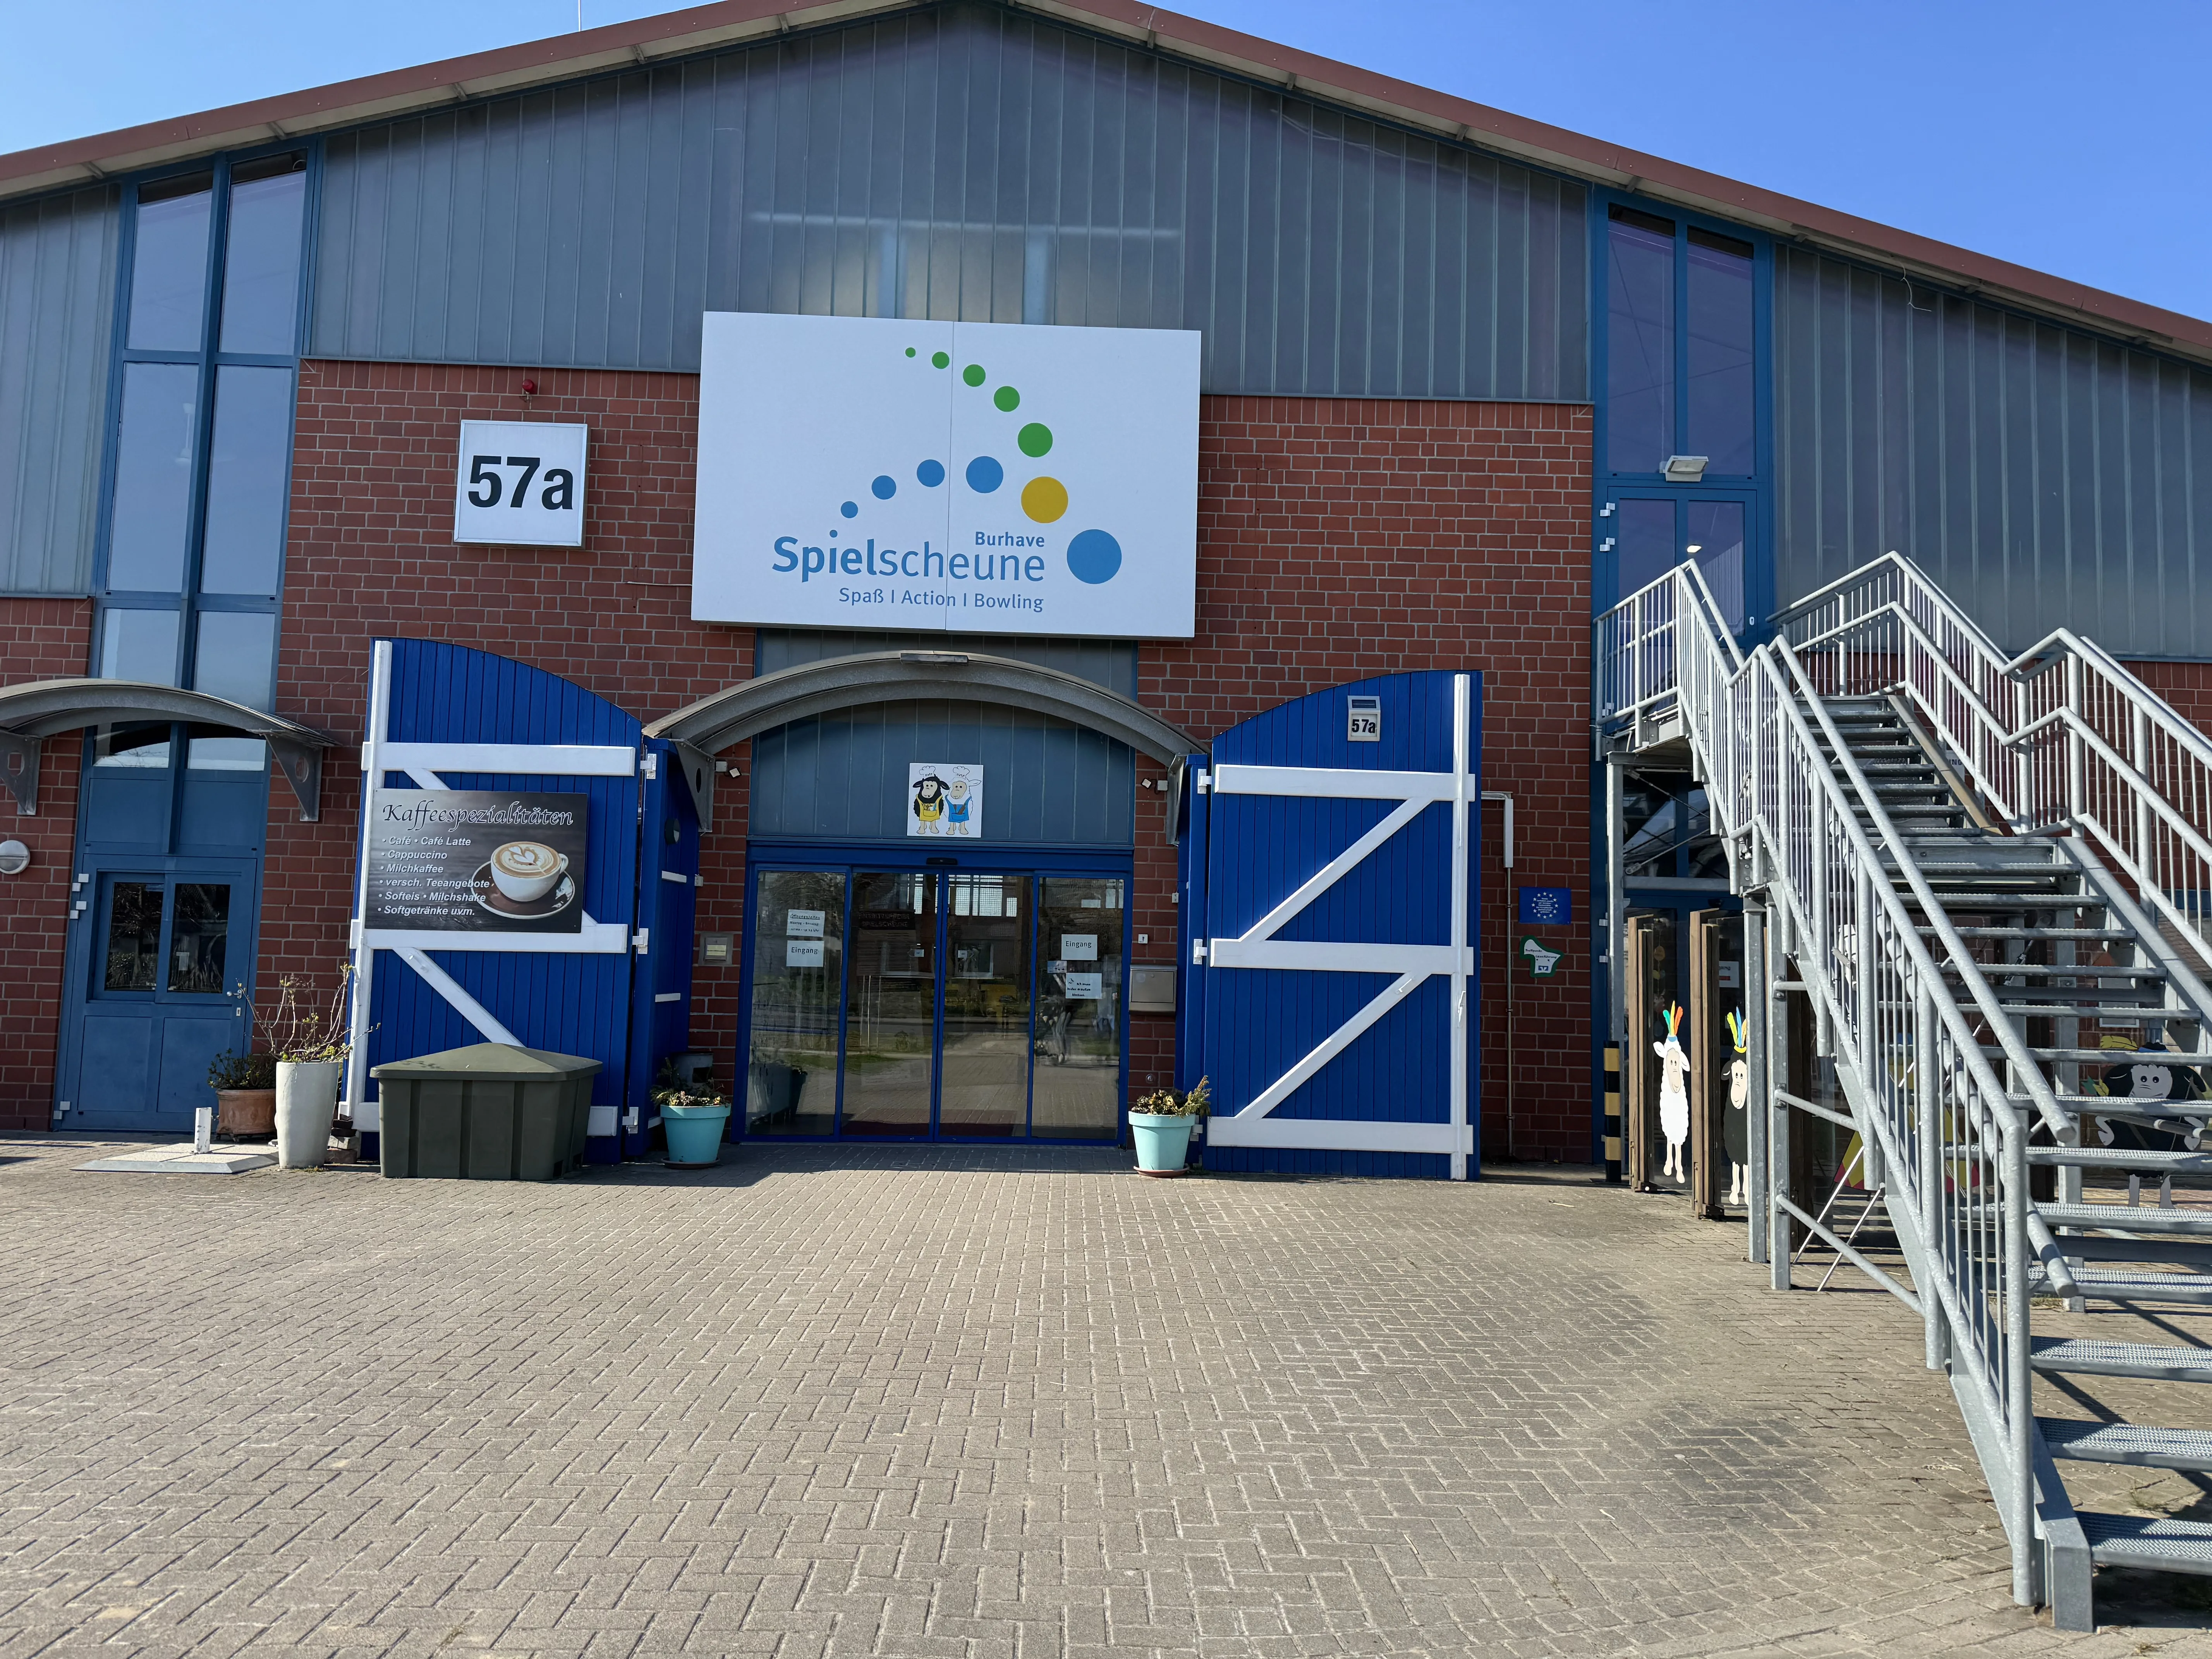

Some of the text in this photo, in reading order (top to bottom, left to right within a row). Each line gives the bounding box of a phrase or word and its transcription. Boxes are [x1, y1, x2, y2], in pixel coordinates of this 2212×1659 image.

[468, 455, 573, 510] 57a
[975, 531, 1045, 547] Burhave
[772, 529, 1045, 583] Spielscheune
[839, 587, 884, 606] Spaß
[901, 590, 956, 606] Action
[974, 593, 1044, 613] Bowling
[1352, 719, 1376, 733] 57a
[382, 800, 574, 832] Kaffeespezialitäten
[388, 836, 471, 846] Café Café Latte
[387, 850, 448, 860] Cappuccino
[386, 864, 444, 873] Milchkaffee
[386, 878, 490, 889] versch. Teeangebote
[385, 891, 486, 902] Softeis Milchshake
[384, 905, 448, 916] Softgetränke
